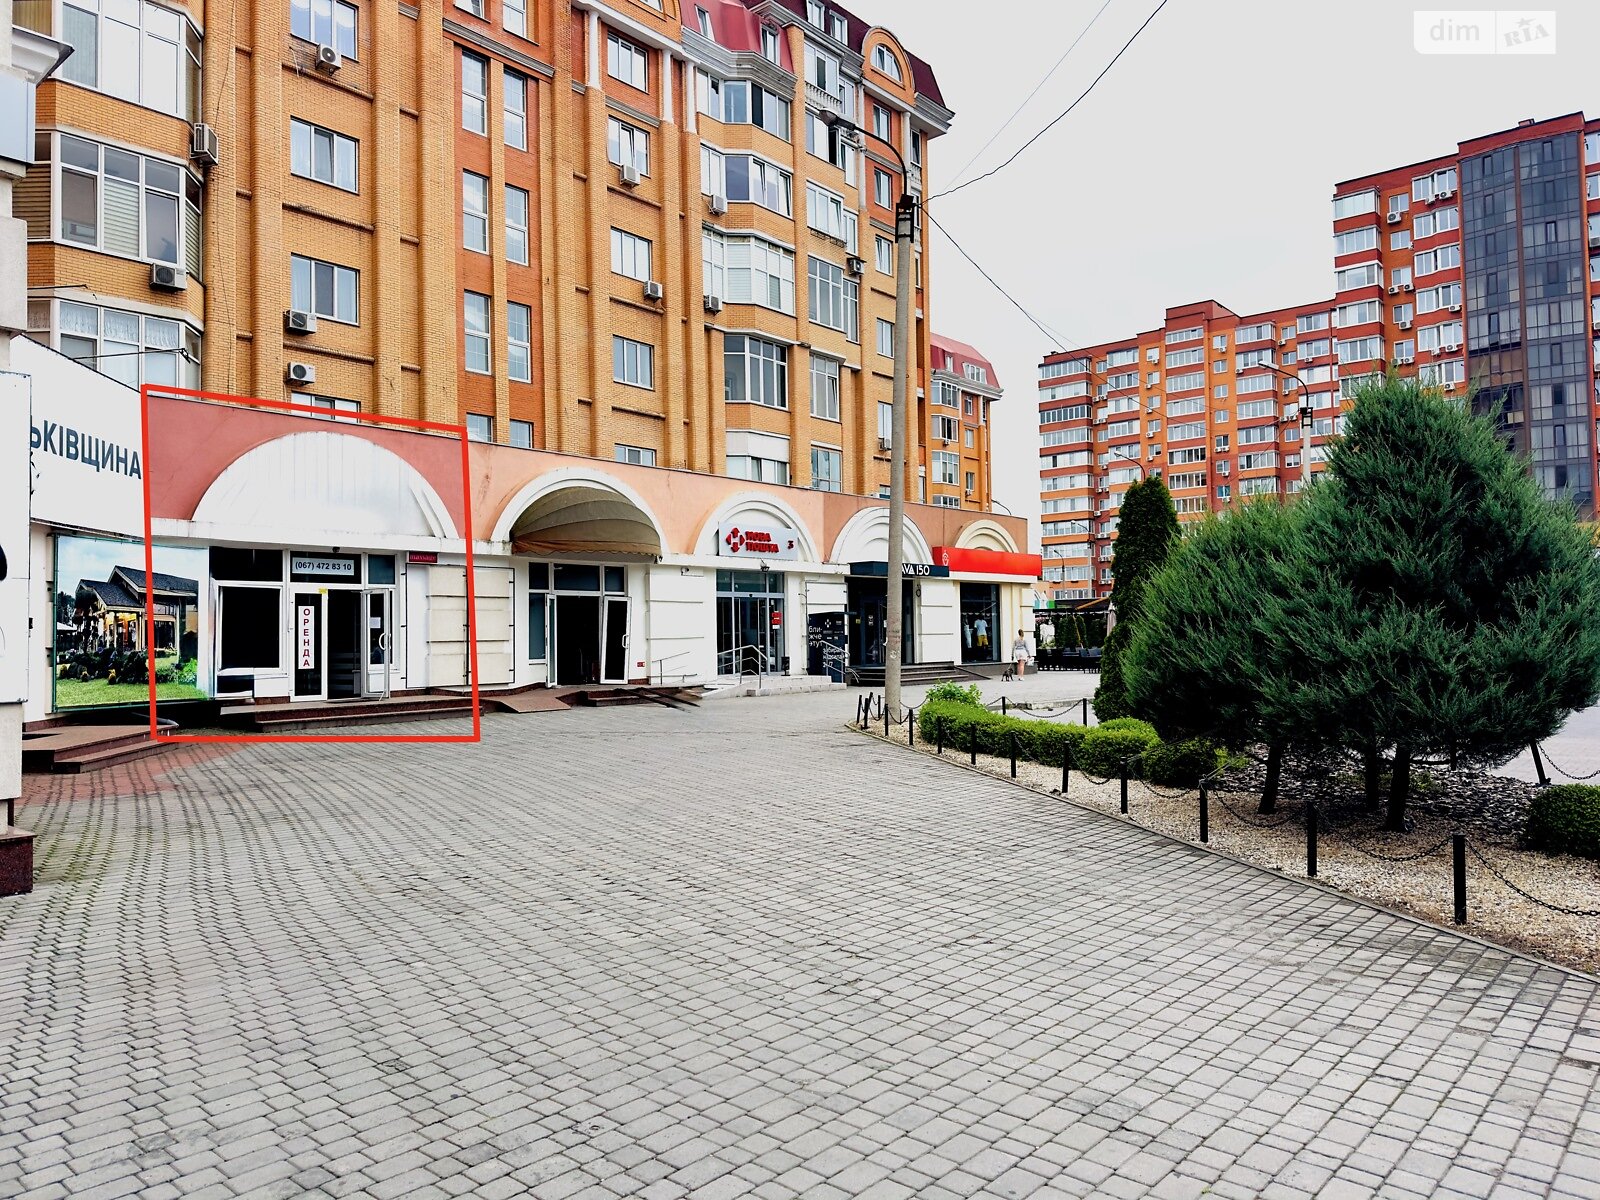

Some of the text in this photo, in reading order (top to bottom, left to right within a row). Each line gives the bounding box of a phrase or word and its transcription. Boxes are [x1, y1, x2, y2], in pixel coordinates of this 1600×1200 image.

[295, 561, 315, 571] (067)
[316, 562, 330, 570] 472
[342, 563, 352, 571] 10
[303, 608, 311, 667] ОРЕНДА
